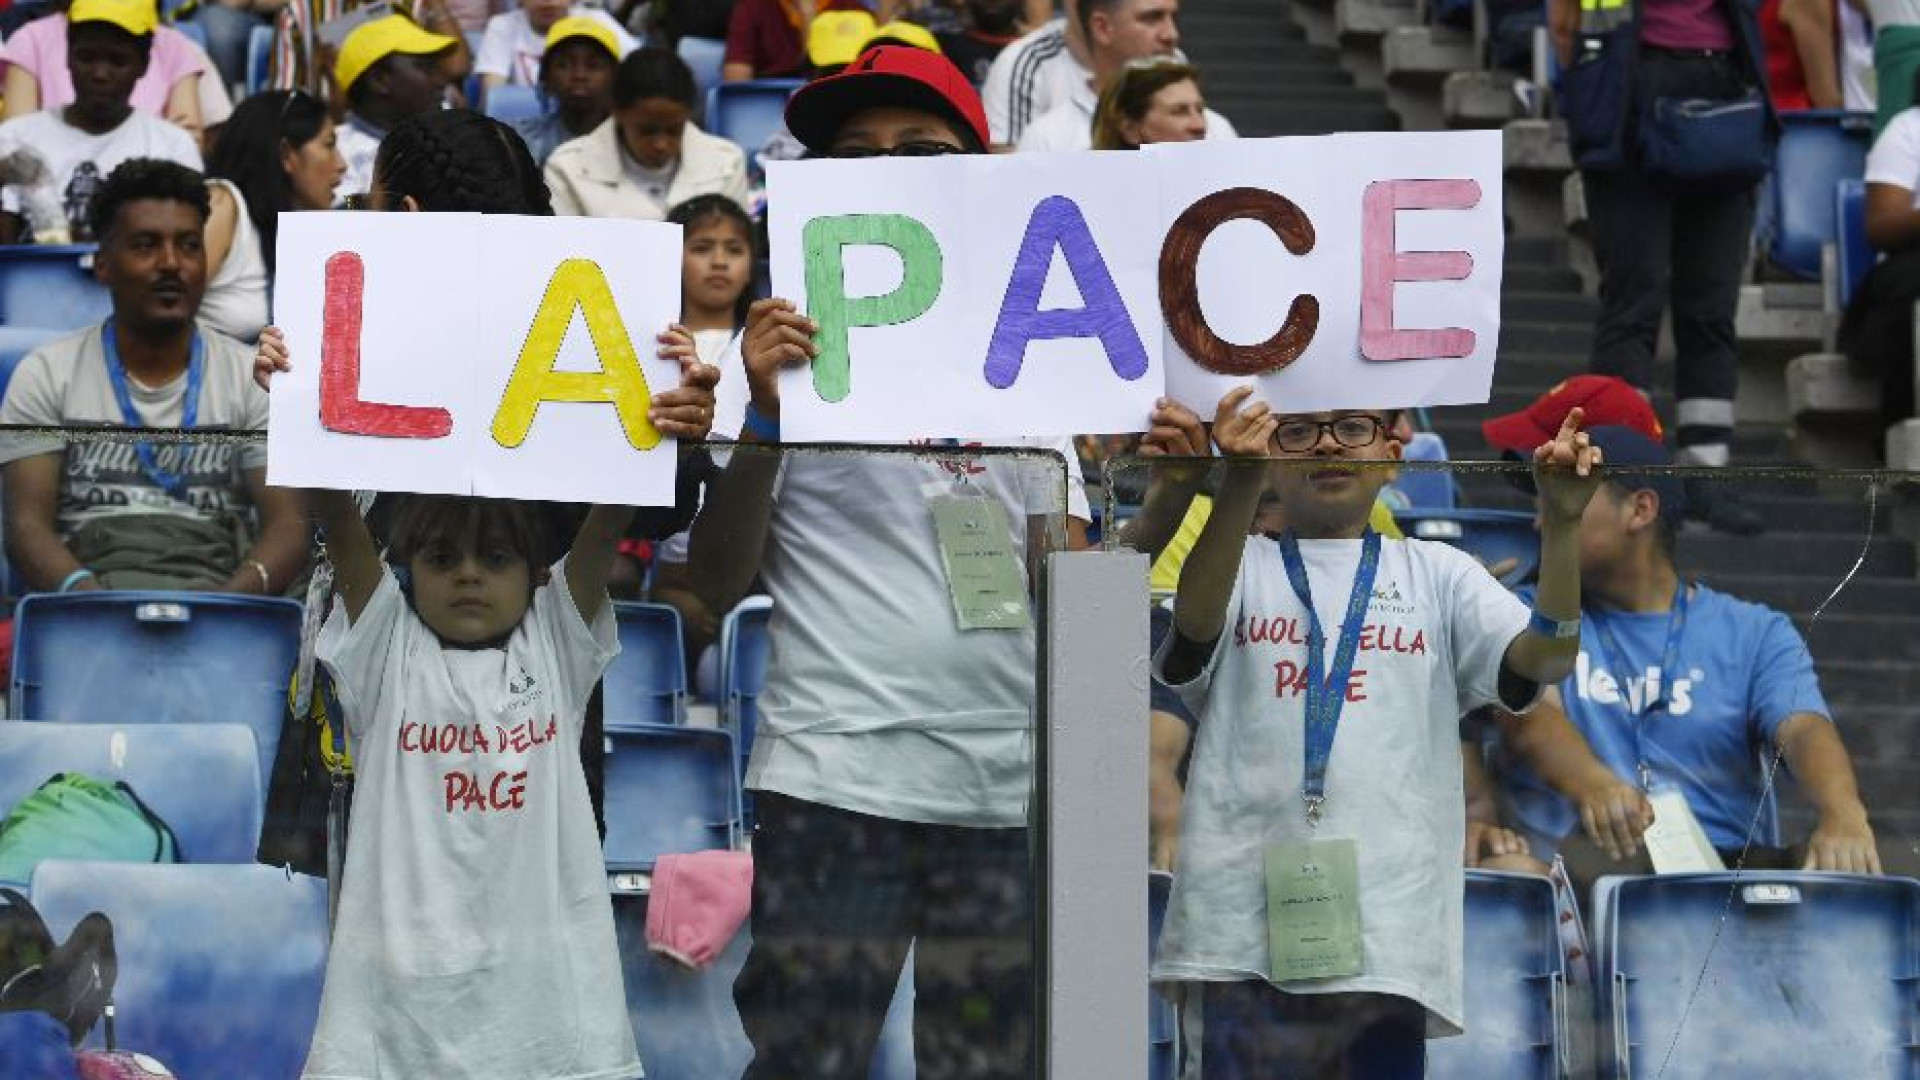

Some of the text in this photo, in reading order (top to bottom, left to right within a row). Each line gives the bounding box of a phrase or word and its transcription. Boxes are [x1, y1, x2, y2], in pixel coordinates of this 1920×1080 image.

[802, 178, 1483, 403] PACE
[318, 250, 662, 451] LA
[1338, 624, 1426, 655] ELLA
[1274, 659, 1367, 702] PAE
[398, 720, 489, 753] CUOLA
[444, 770, 528, 813] PACE
